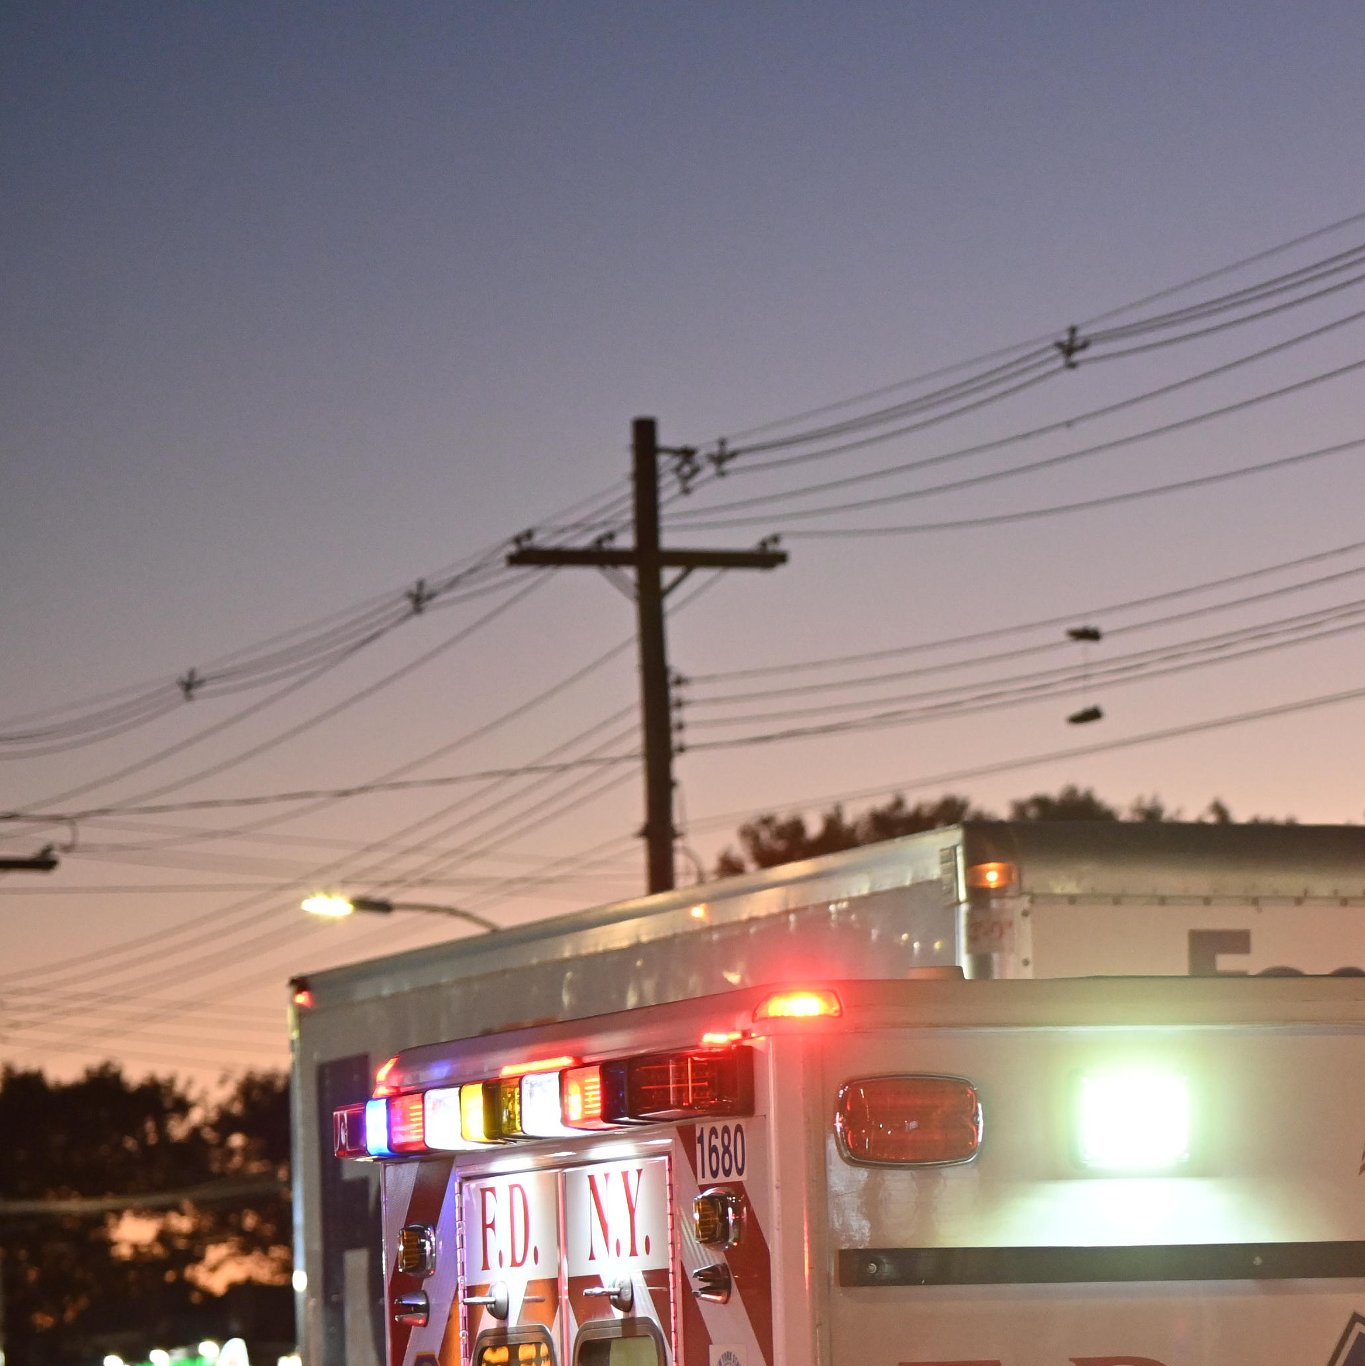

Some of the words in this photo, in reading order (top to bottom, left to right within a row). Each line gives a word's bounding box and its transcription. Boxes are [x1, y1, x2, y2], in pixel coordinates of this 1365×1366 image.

[696, 1123, 747, 1179] 1680
[479, 1182, 540, 1272] F.D.
[587, 1167, 652, 1261] N.Y.
